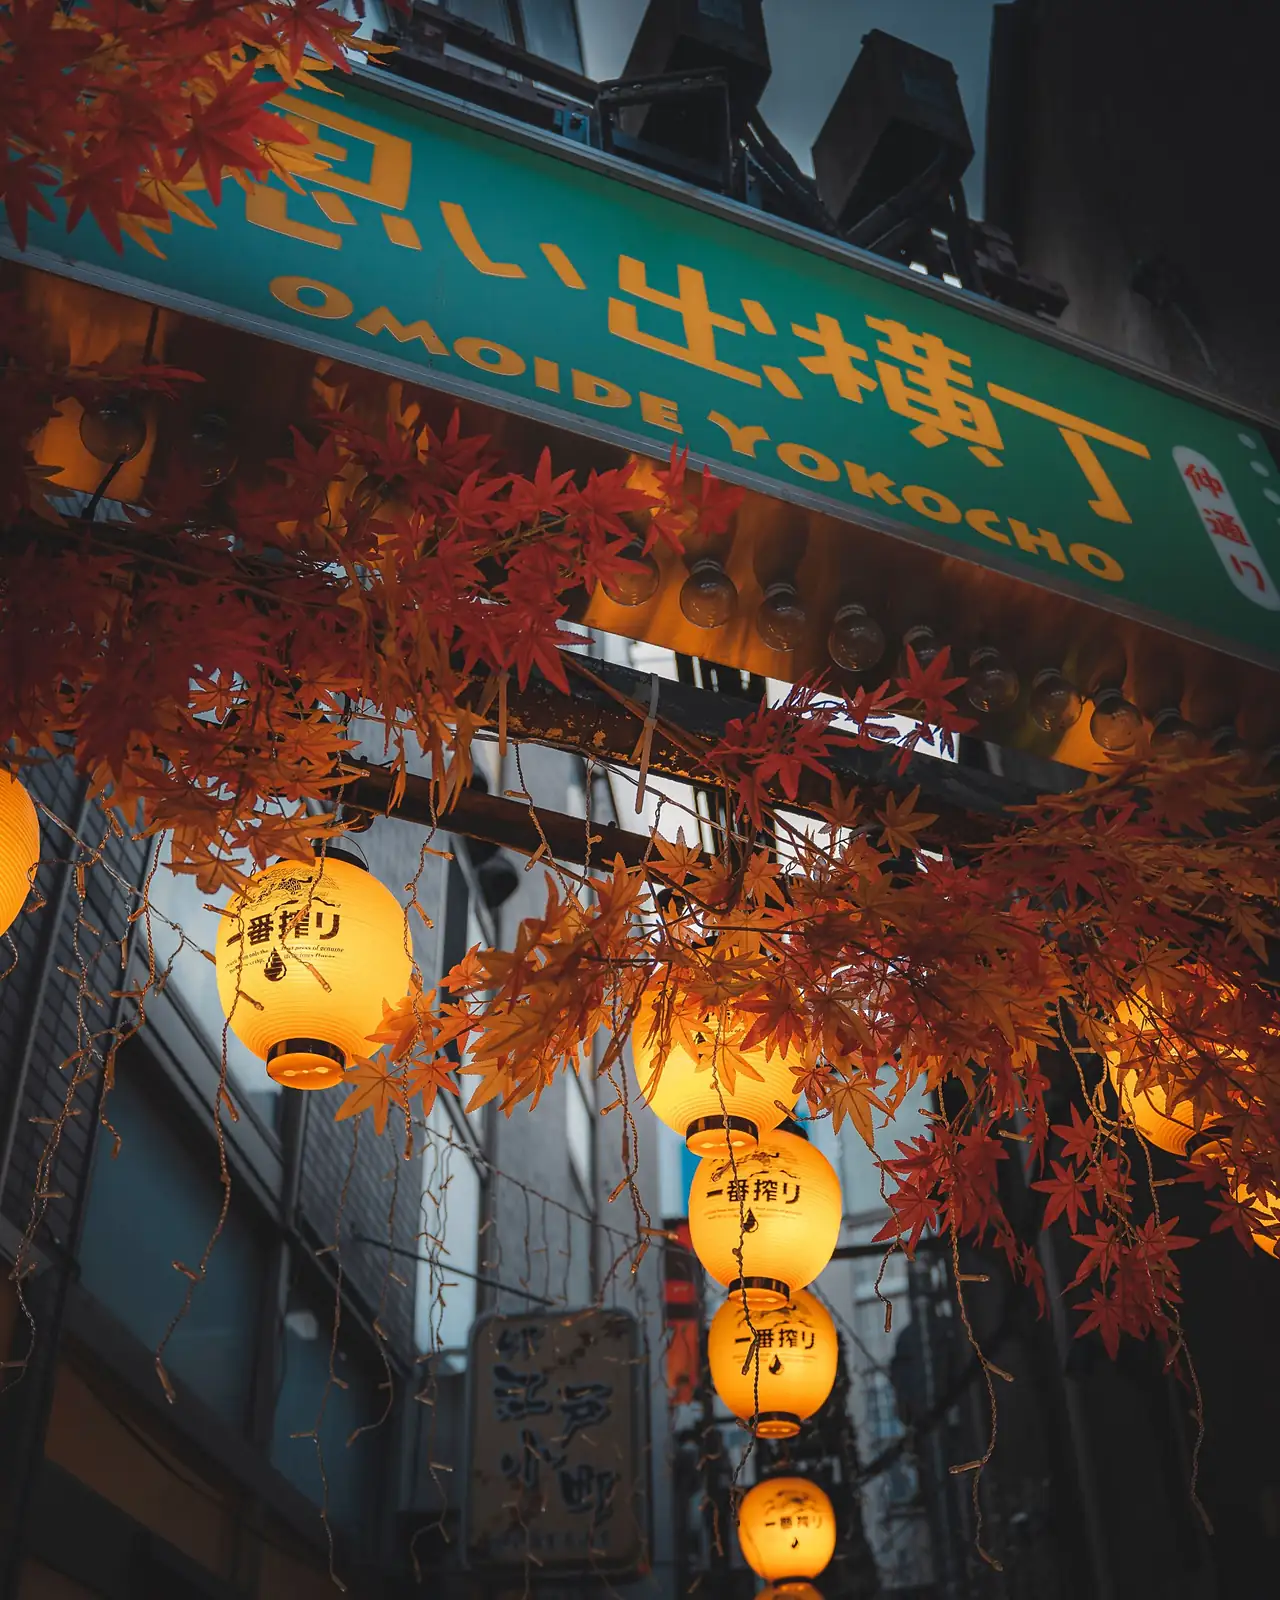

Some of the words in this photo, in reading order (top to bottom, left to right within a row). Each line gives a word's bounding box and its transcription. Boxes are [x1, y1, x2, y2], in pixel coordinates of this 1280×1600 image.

[268, 274, 685, 436] OMOIDE
[707, 410, 1125, 583] YOKOCHO
[1183, 461, 1266, 594] 仲通り
[706, 1178, 801, 1205] 一番搾り
